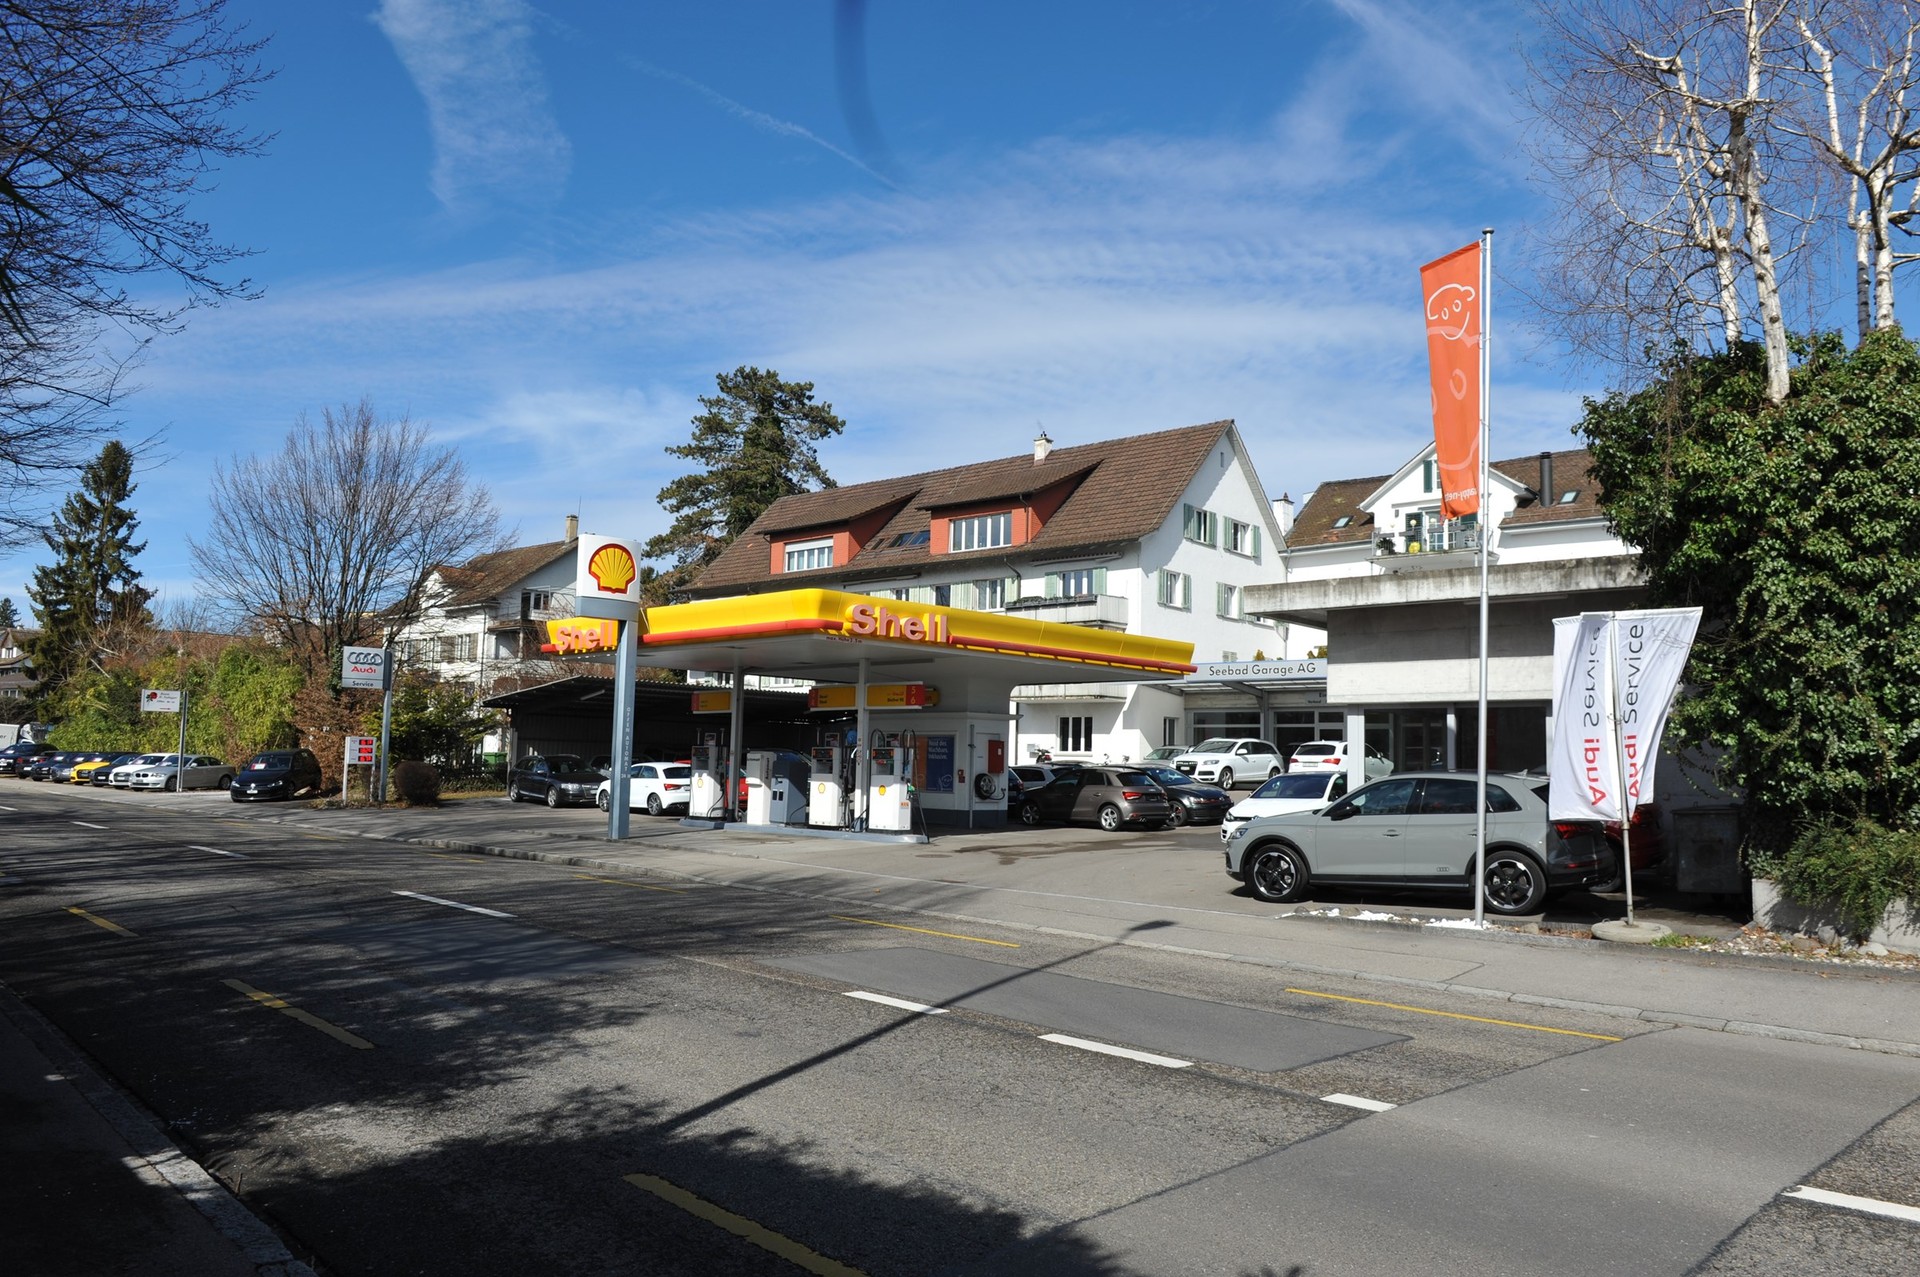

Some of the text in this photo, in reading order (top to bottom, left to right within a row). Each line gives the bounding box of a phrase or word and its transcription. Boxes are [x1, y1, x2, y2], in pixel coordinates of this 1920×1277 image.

[852, 604, 948, 643] Shell
[555, 620, 613, 651] Shell
[351, 665, 376, 674] Audi
[1209, 662, 1316, 677] Seebad Garage AG
[912, 686, 916, 694] 5
[1623, 624, 1644, 798] Audi Service
